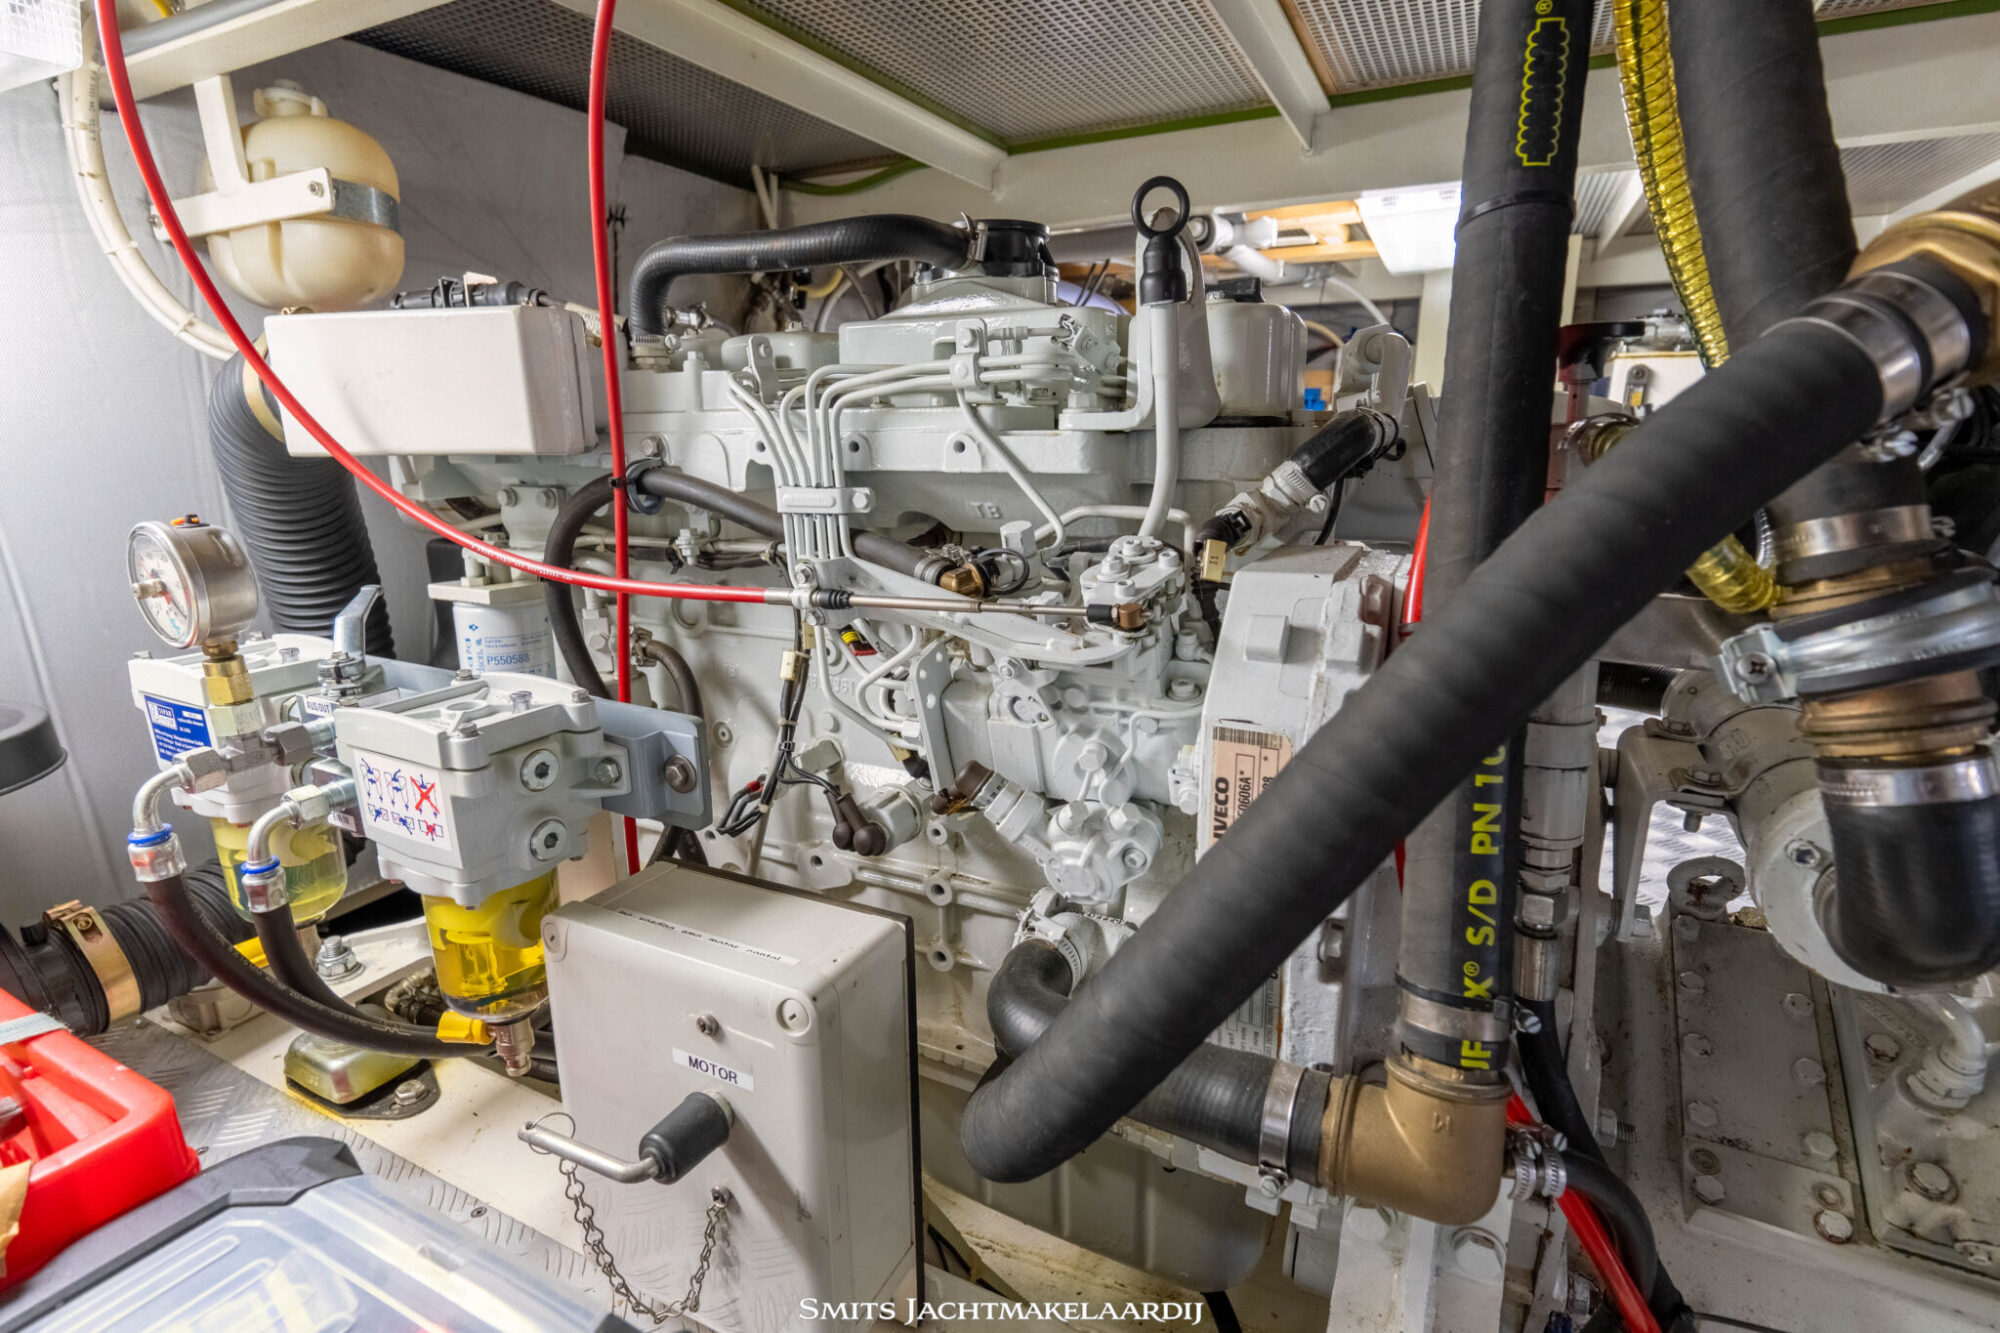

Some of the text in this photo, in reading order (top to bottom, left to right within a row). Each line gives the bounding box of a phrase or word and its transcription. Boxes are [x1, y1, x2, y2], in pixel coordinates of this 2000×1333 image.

[1213, 777, 1229, 839] IVECO
[1470, 803, 1503, 855] PN
[1465, 879, 1497, 947] S/D
[688, 1055, 738, 1085] MOTOR
